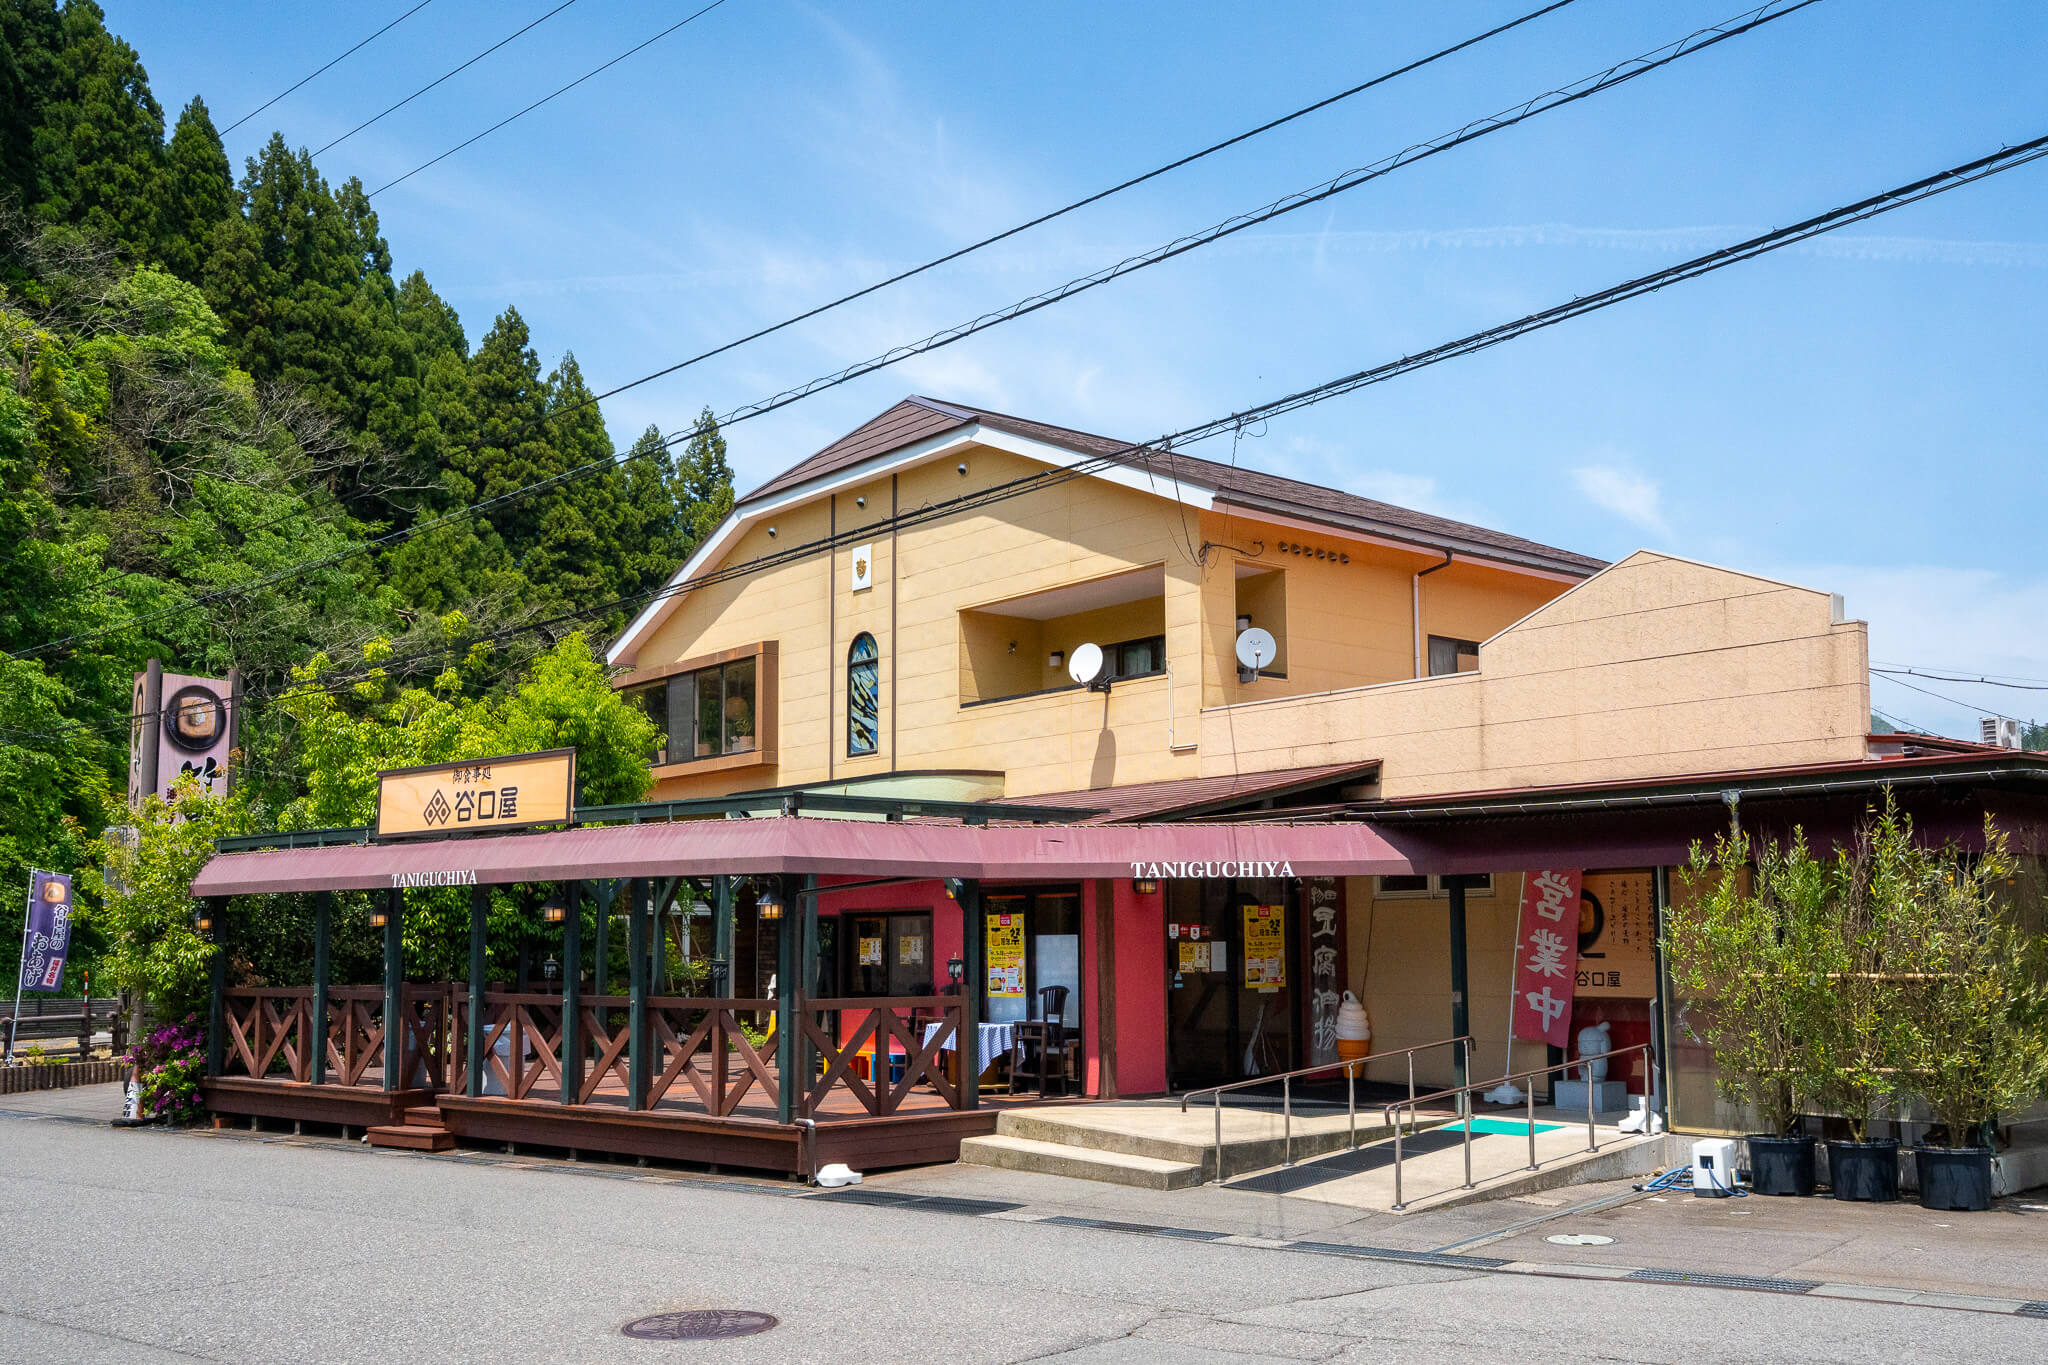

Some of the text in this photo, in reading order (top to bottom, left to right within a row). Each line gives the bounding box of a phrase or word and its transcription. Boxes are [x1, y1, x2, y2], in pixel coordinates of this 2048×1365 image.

[453, 766, 492, 784] 御食事処
[455, 787, 518, 822] 谷口屋
[392, 870, 478, 888] TANIGUCHIYA
[1130, 861, 1296, 878] TANIGUCHIYA
[50, 904, 69, 950] 谷口屋の
[24, 931, 49, 987] おあげ
[1525, 870, 1574, 1033] 営業中
[1575, 971, 1621, 987] 谷口屋
